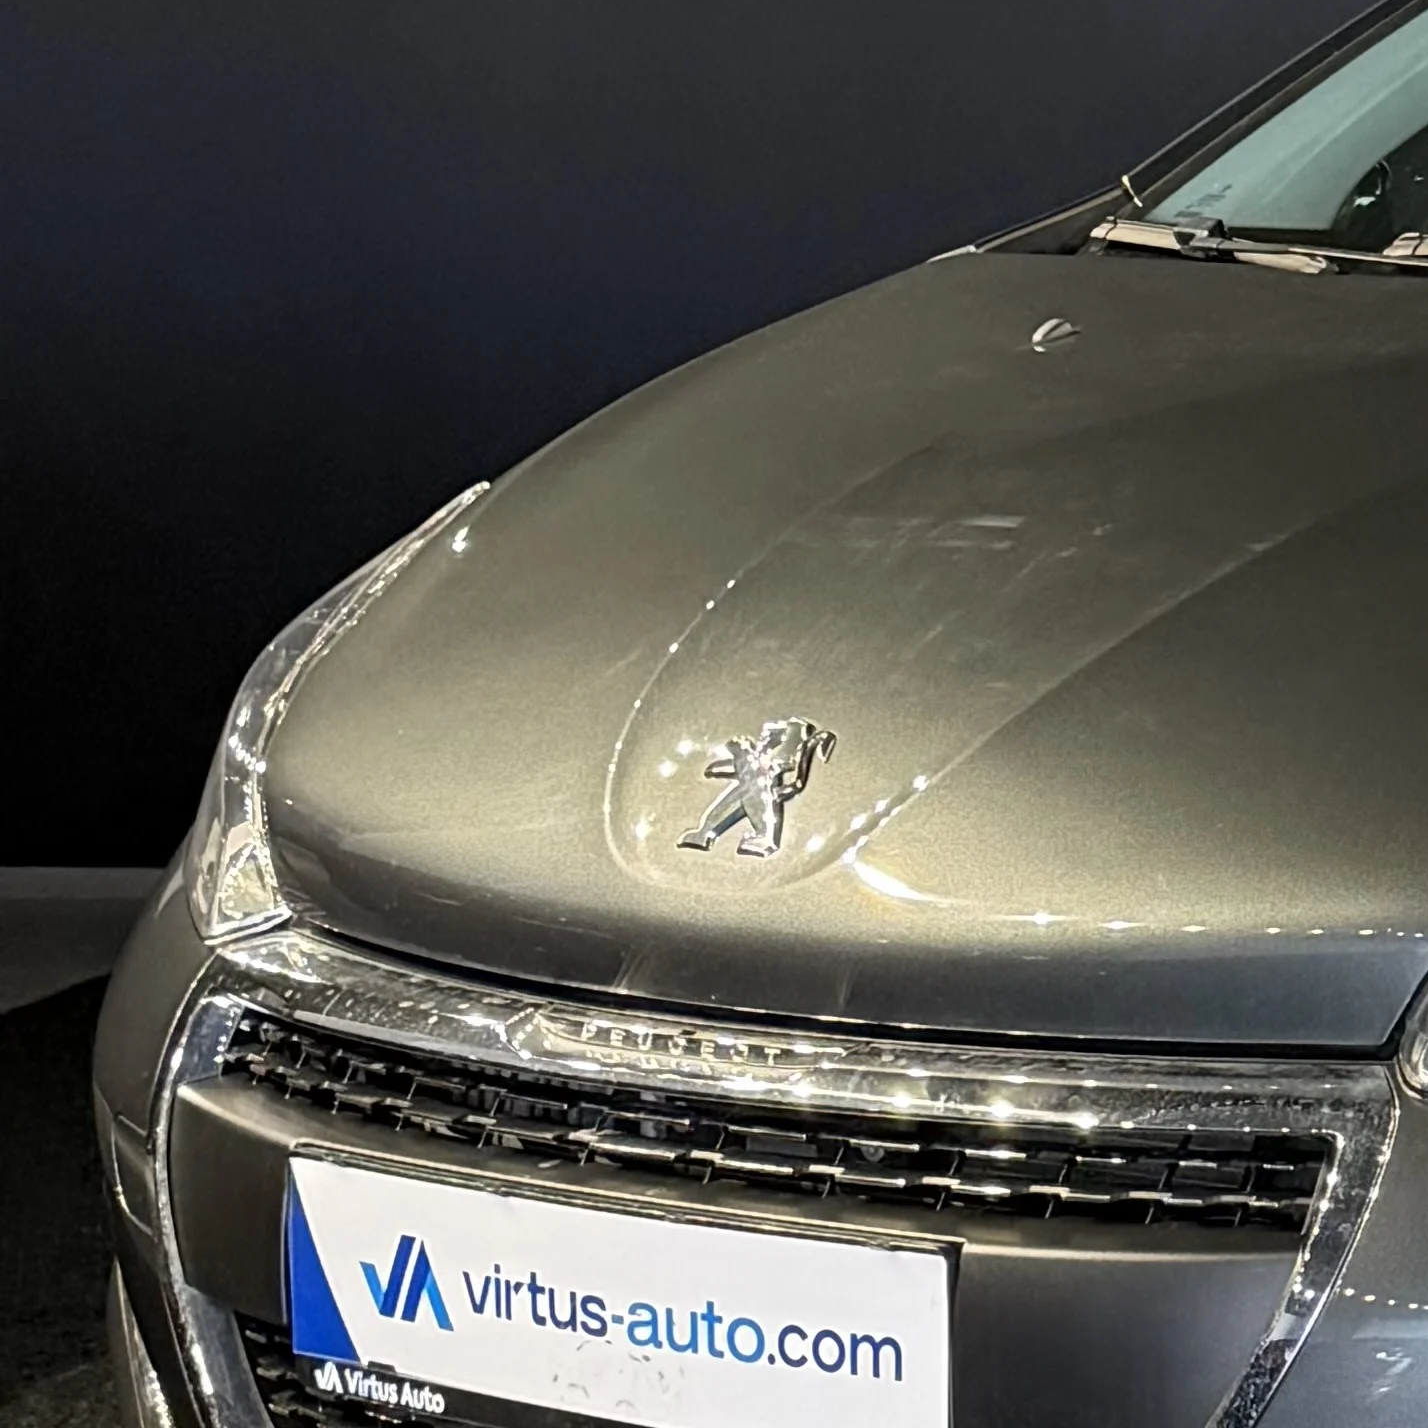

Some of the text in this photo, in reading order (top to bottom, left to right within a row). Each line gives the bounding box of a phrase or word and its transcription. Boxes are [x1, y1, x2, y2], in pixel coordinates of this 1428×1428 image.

[461, 1263, 904, 1382] virtus-auto.com
[344, 1368, 398, 1404] Virtus
[400, 1381, 446, 1414] Auto
